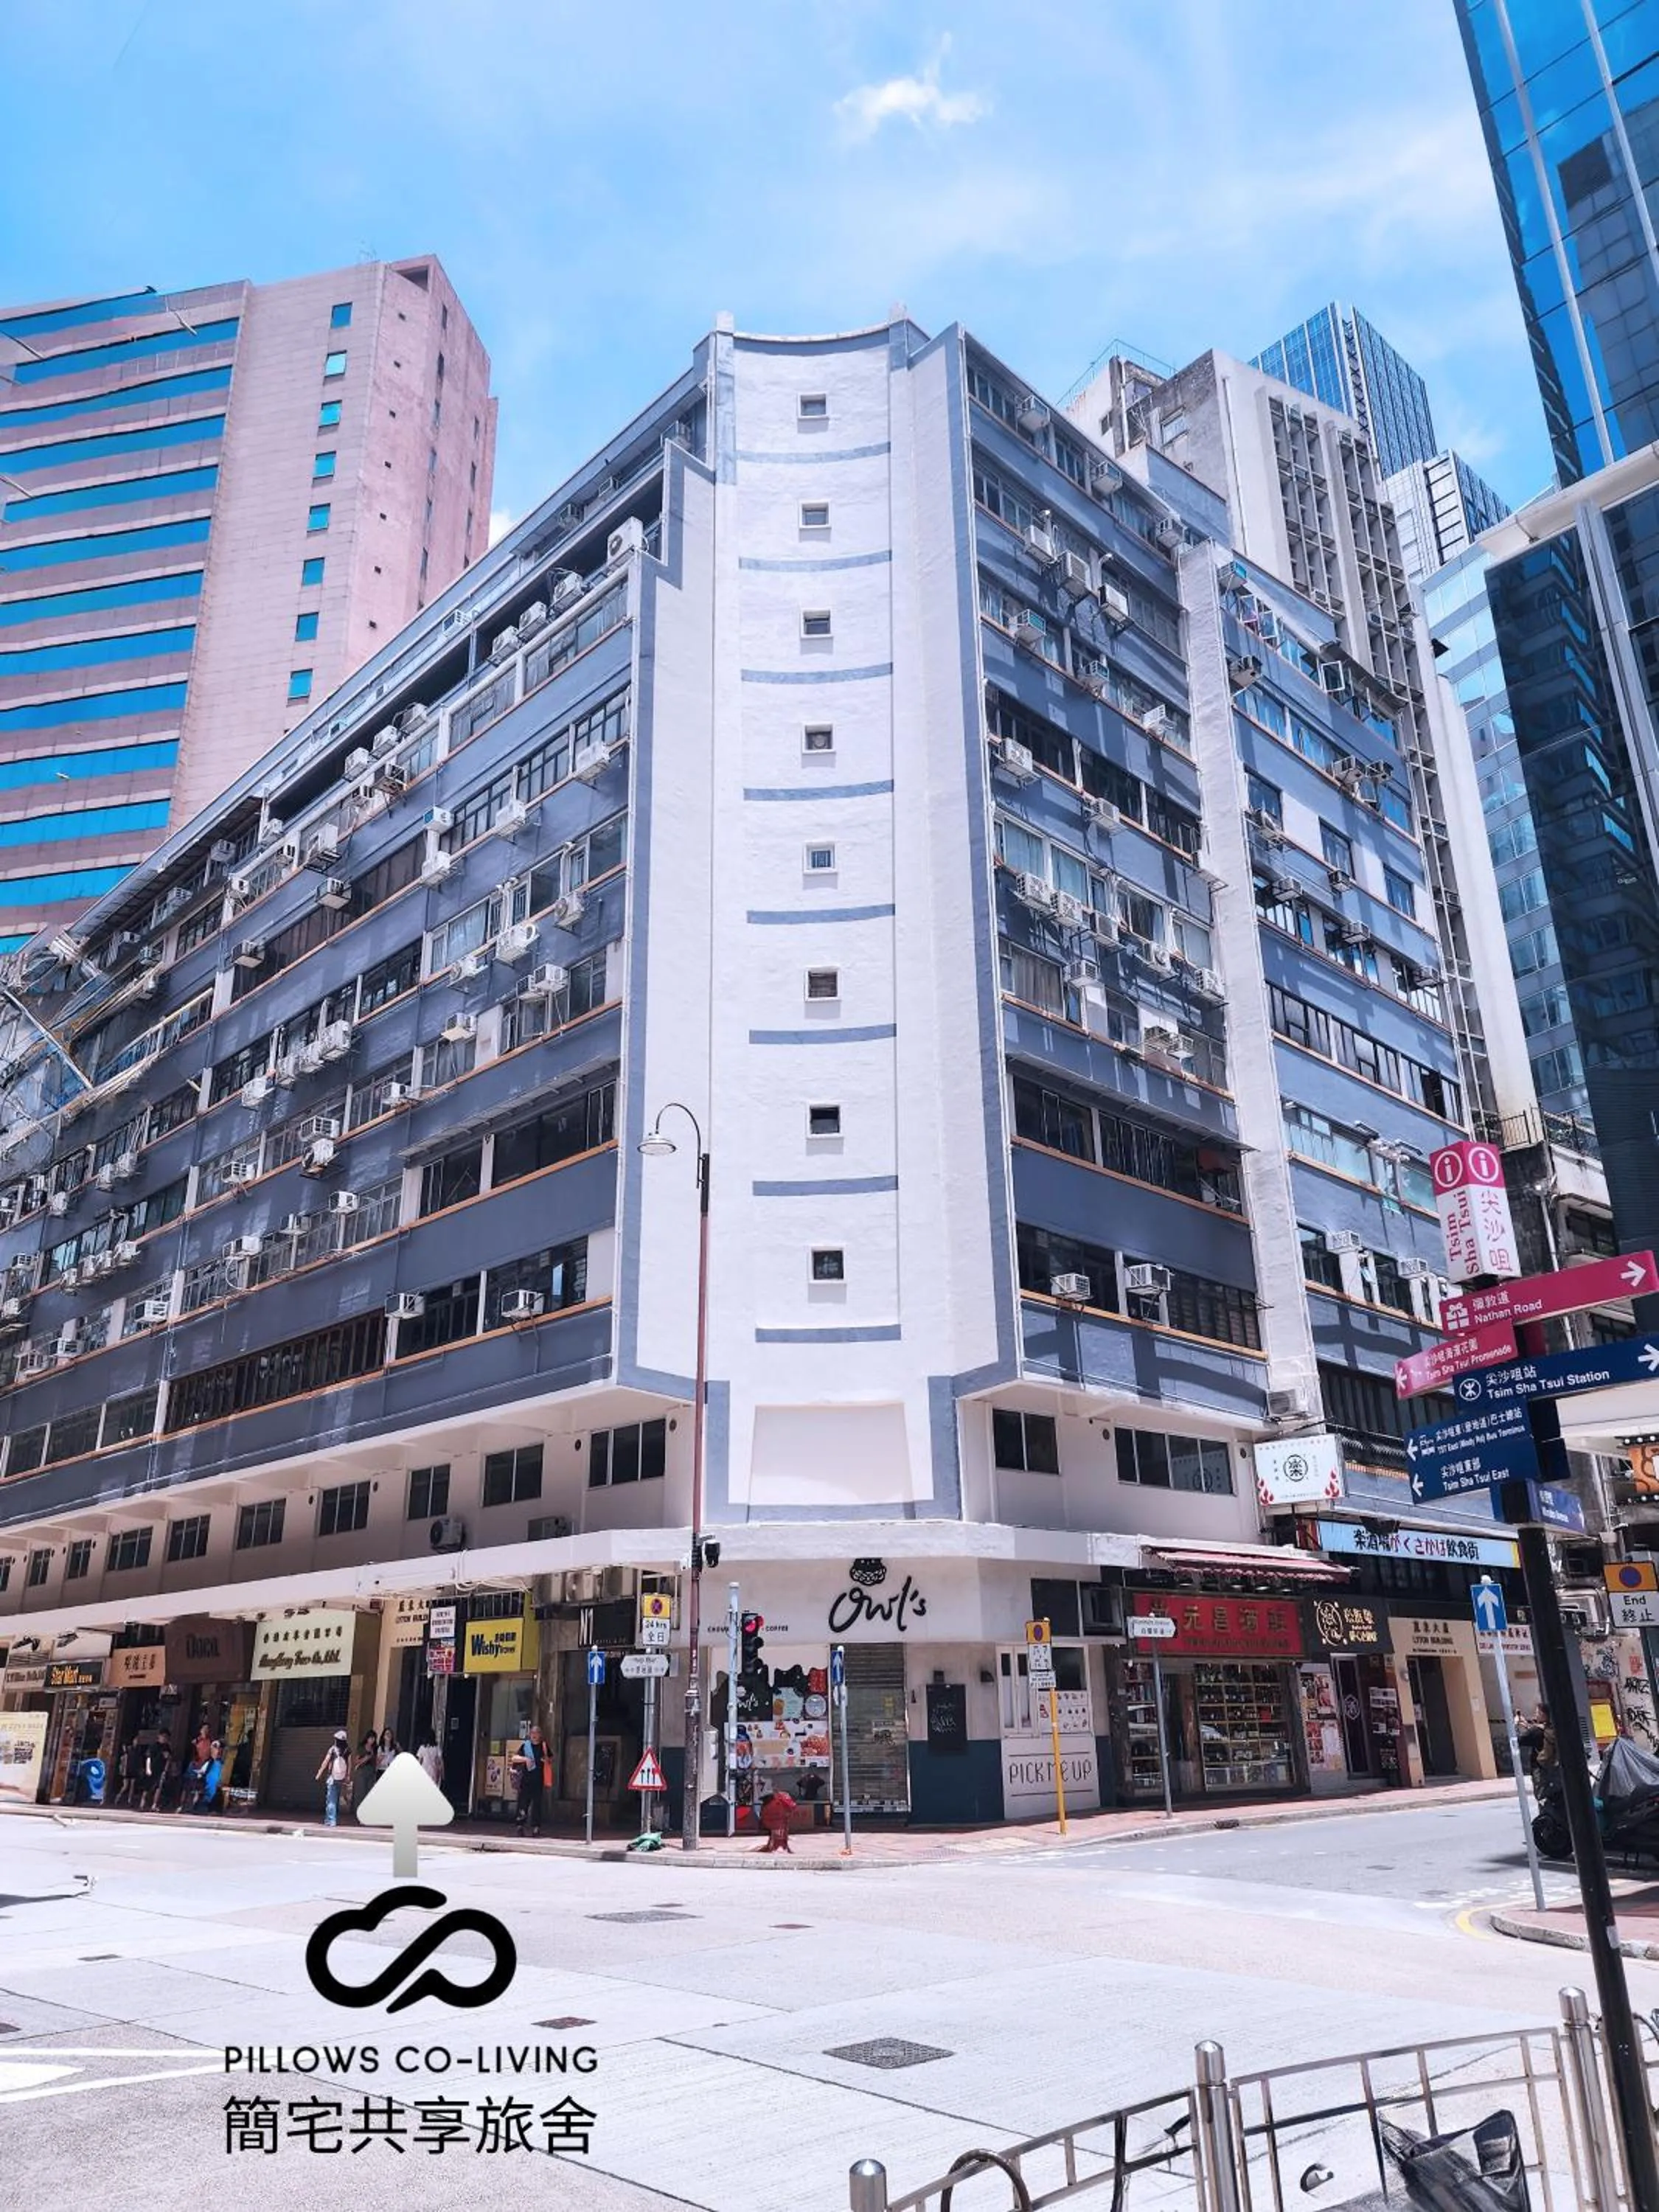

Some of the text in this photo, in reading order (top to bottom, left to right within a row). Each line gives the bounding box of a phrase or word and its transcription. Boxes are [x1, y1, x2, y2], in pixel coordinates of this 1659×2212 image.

[1447, 1211, 1462, 1262] Tsim
[1453, 1189, 1480, 1276] Sha Tsui
[1481, 1189, 1513, 1272] 尖沙咀
[1472, 1290, 1511, 1311] 彌敦道
[1475, 1299, 1543, 1324] Nathan Road
[1441, 1364, 1455, 1374] Sha
[1455, 1360, 1469, 1370] Tsui
[1471, 1344, 1512, 1365] Promenade
[1486, 1364, 1537, 1386] 尖沙咀站
[1487, 1370, 1610, 1399] Tsim Sha Tsui Station
[1486, 1433, 1498, 1441] Bus
[1498, 1425, 1526, 1437] Terminus
[1443, 1467, 1509, 1492] Tsim Sha Tsui East
[829, 1576, 927, 1633] Owl's
[1624, 1596, 1646, 1605] End
[645, 1620, 654, 1628] 24
[1621, 1607, 1655, 1622] 終止
[472, 1633, 501, 1658] Wishy
[647, 1631, 664, 1643] 全日
[1009, 1761, 1044, 1784] PICK
[1072, 1759, 1092, 1781] UP
